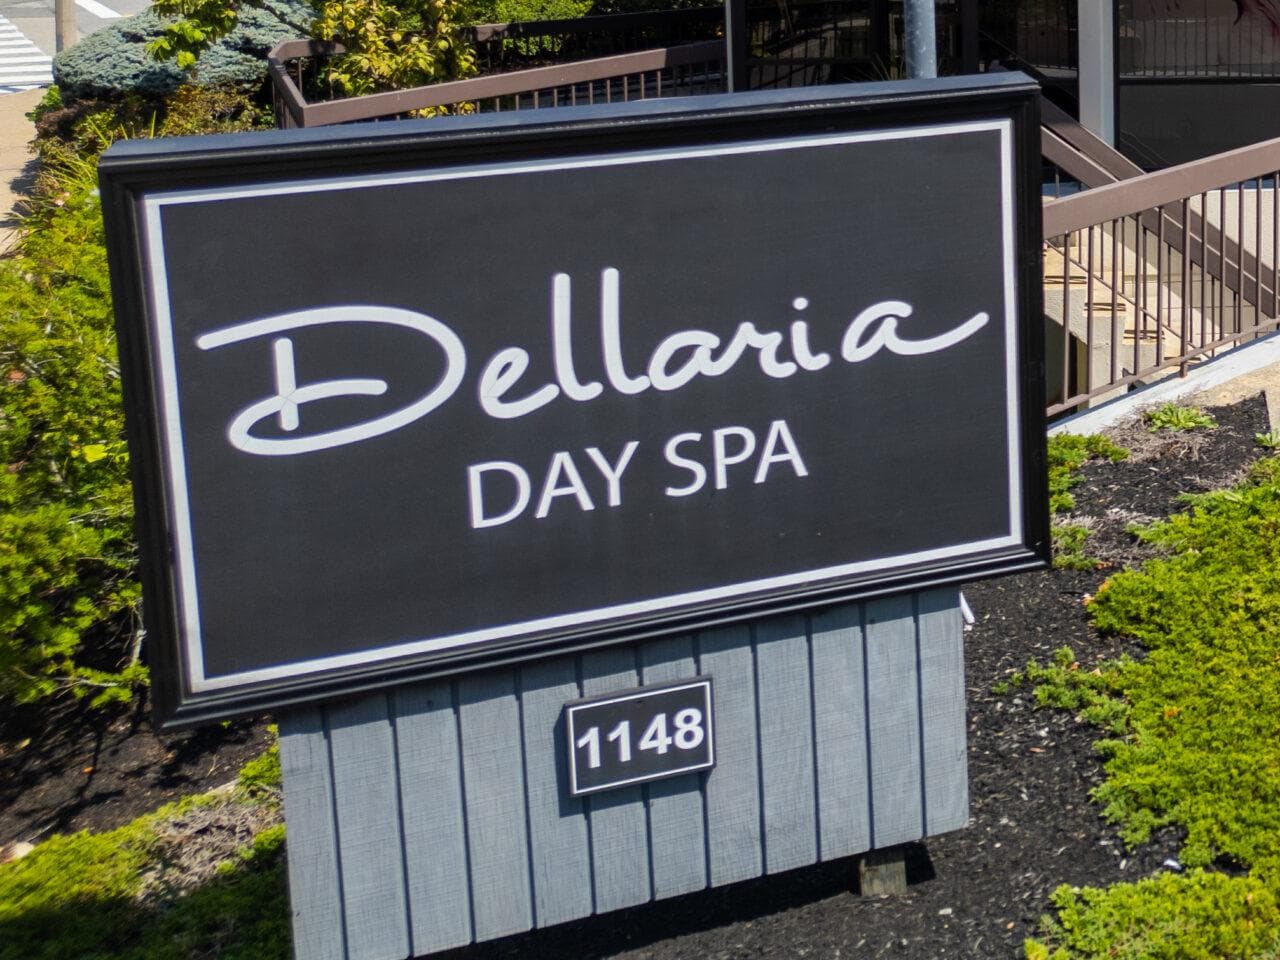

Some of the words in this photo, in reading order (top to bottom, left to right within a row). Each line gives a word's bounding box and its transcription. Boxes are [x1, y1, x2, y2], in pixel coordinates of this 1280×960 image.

[197, 268, 989, 455] Dellaria
[468, 441, 640, 528] DAY
[664, 420, 808, 496] SPA
[576, 707, 704, 768] 1148
